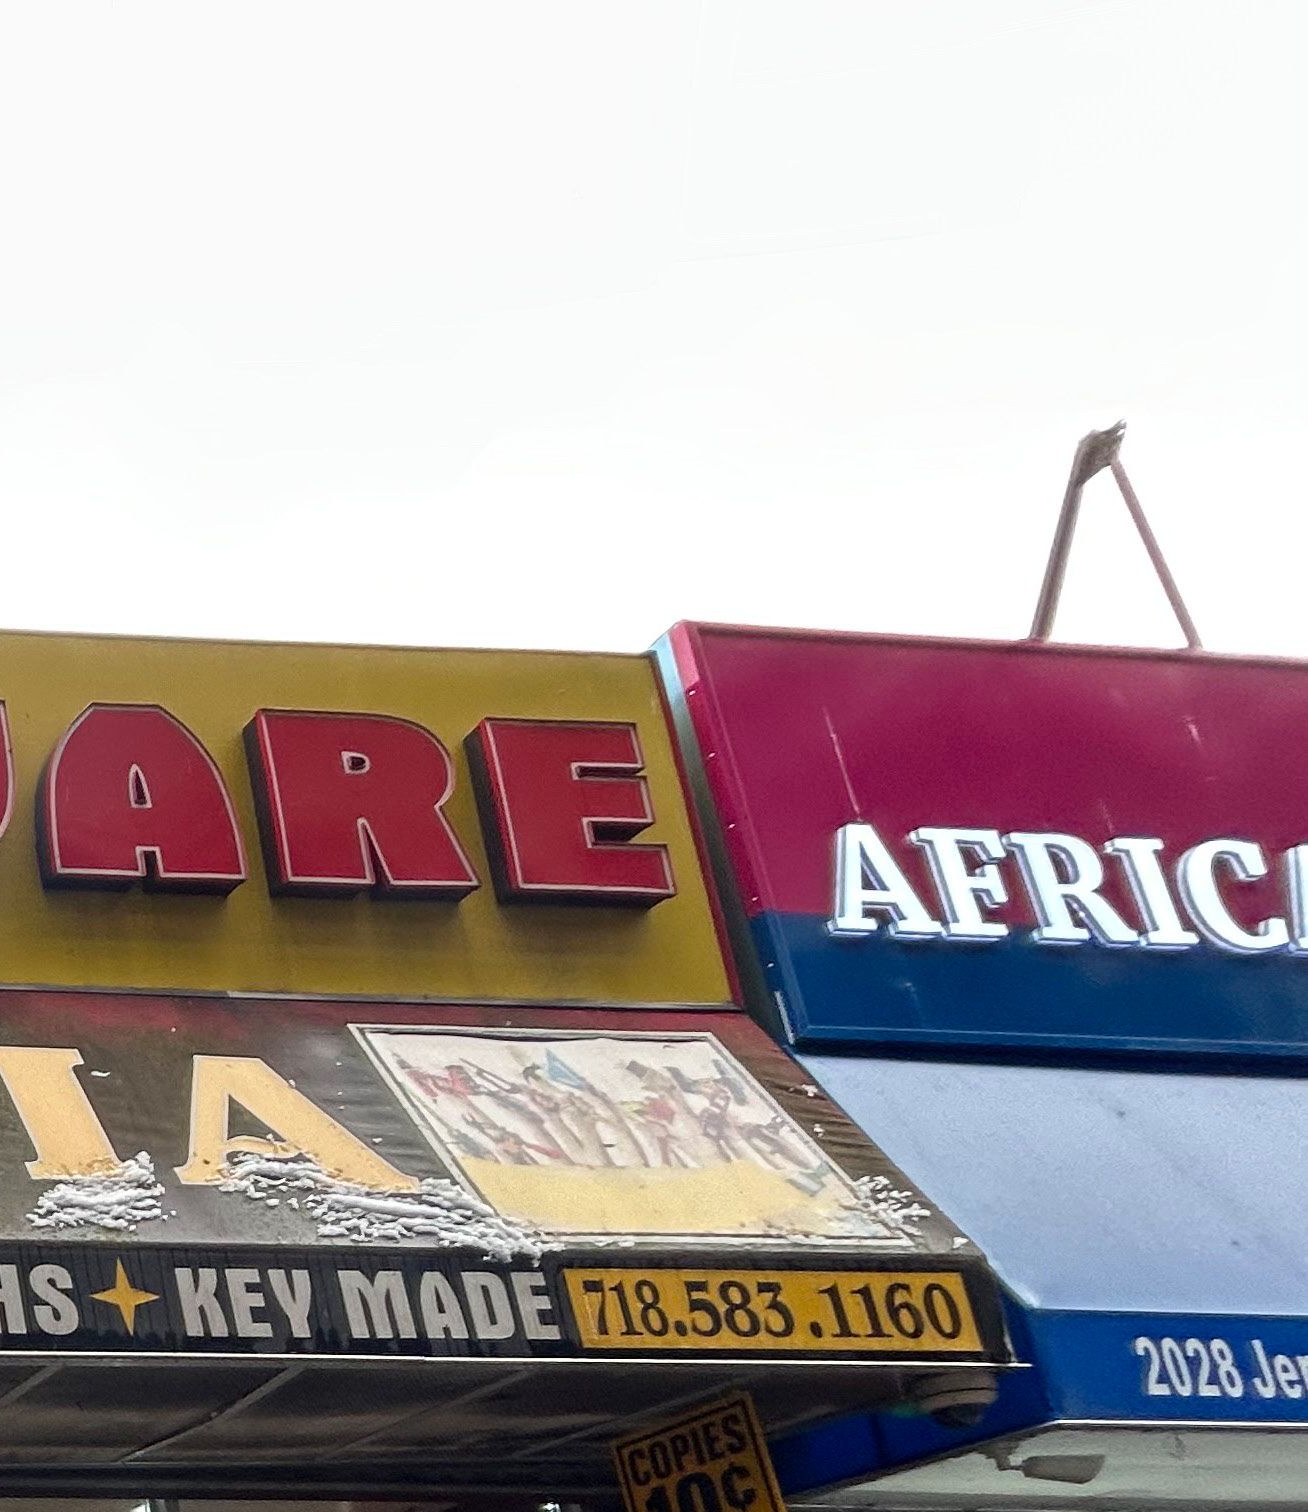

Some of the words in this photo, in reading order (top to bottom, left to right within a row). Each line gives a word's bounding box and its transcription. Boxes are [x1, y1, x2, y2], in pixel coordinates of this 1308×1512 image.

[825, 822, 1308, 957] AFRIC
[173, 1265, 315, 1340] KEY
[338, 1268, 563, 1343] MADE
[1134, 1336, 1244, 1398] 2028
[628, 1413, 748, 1486] COPIES
